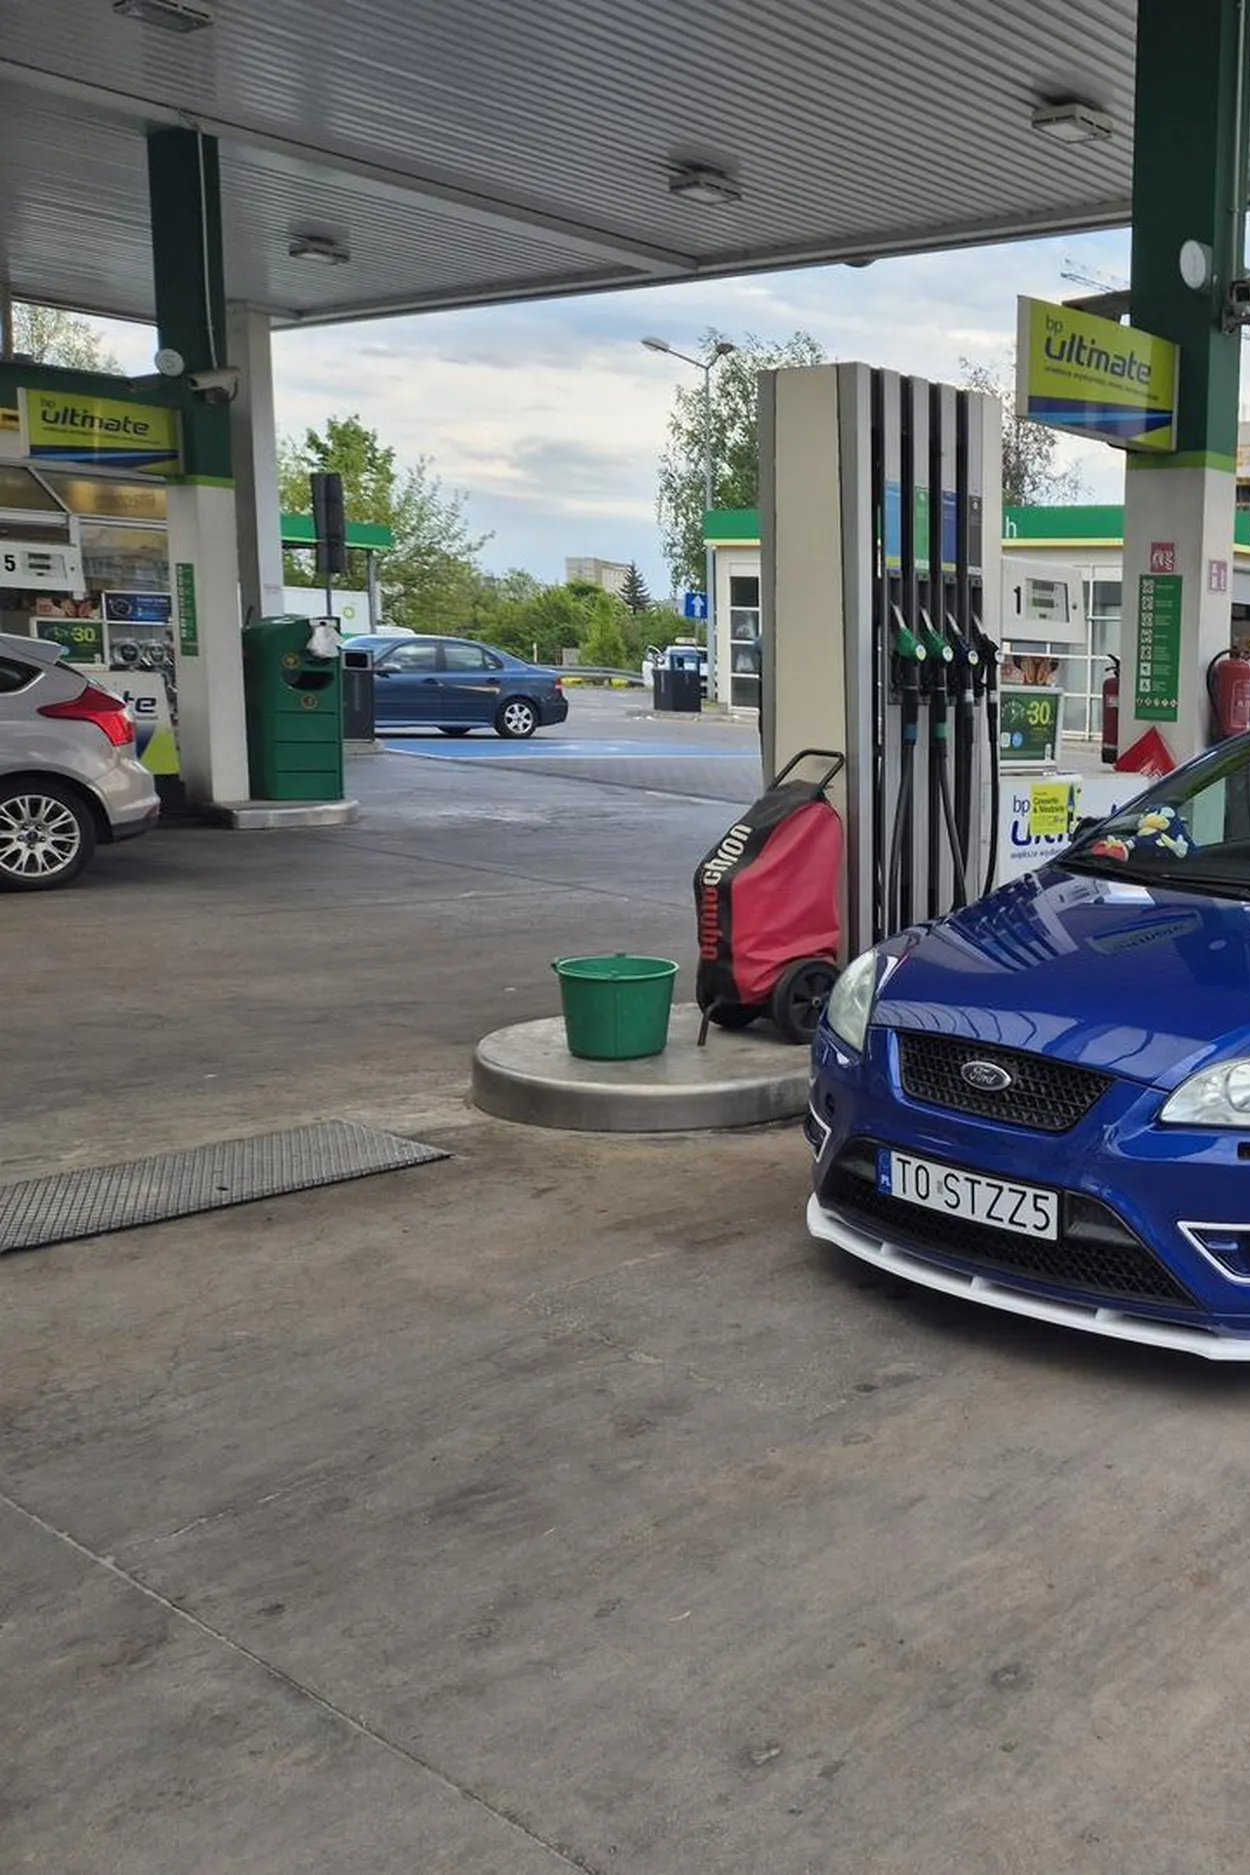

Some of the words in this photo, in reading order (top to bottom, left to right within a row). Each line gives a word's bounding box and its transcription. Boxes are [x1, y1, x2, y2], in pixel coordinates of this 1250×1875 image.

[1045, 314, 1064, 336] bp
[1044, 333, 1152, 386] ultimate
[41, 406, 150, 436] ultimate
[4, 554, 16, 572] 5
[1013, 586, 1022, 614] 1
[1012, 795, 1030, 816] bp
[943, 1173, 1051, 1232] STZZ5
